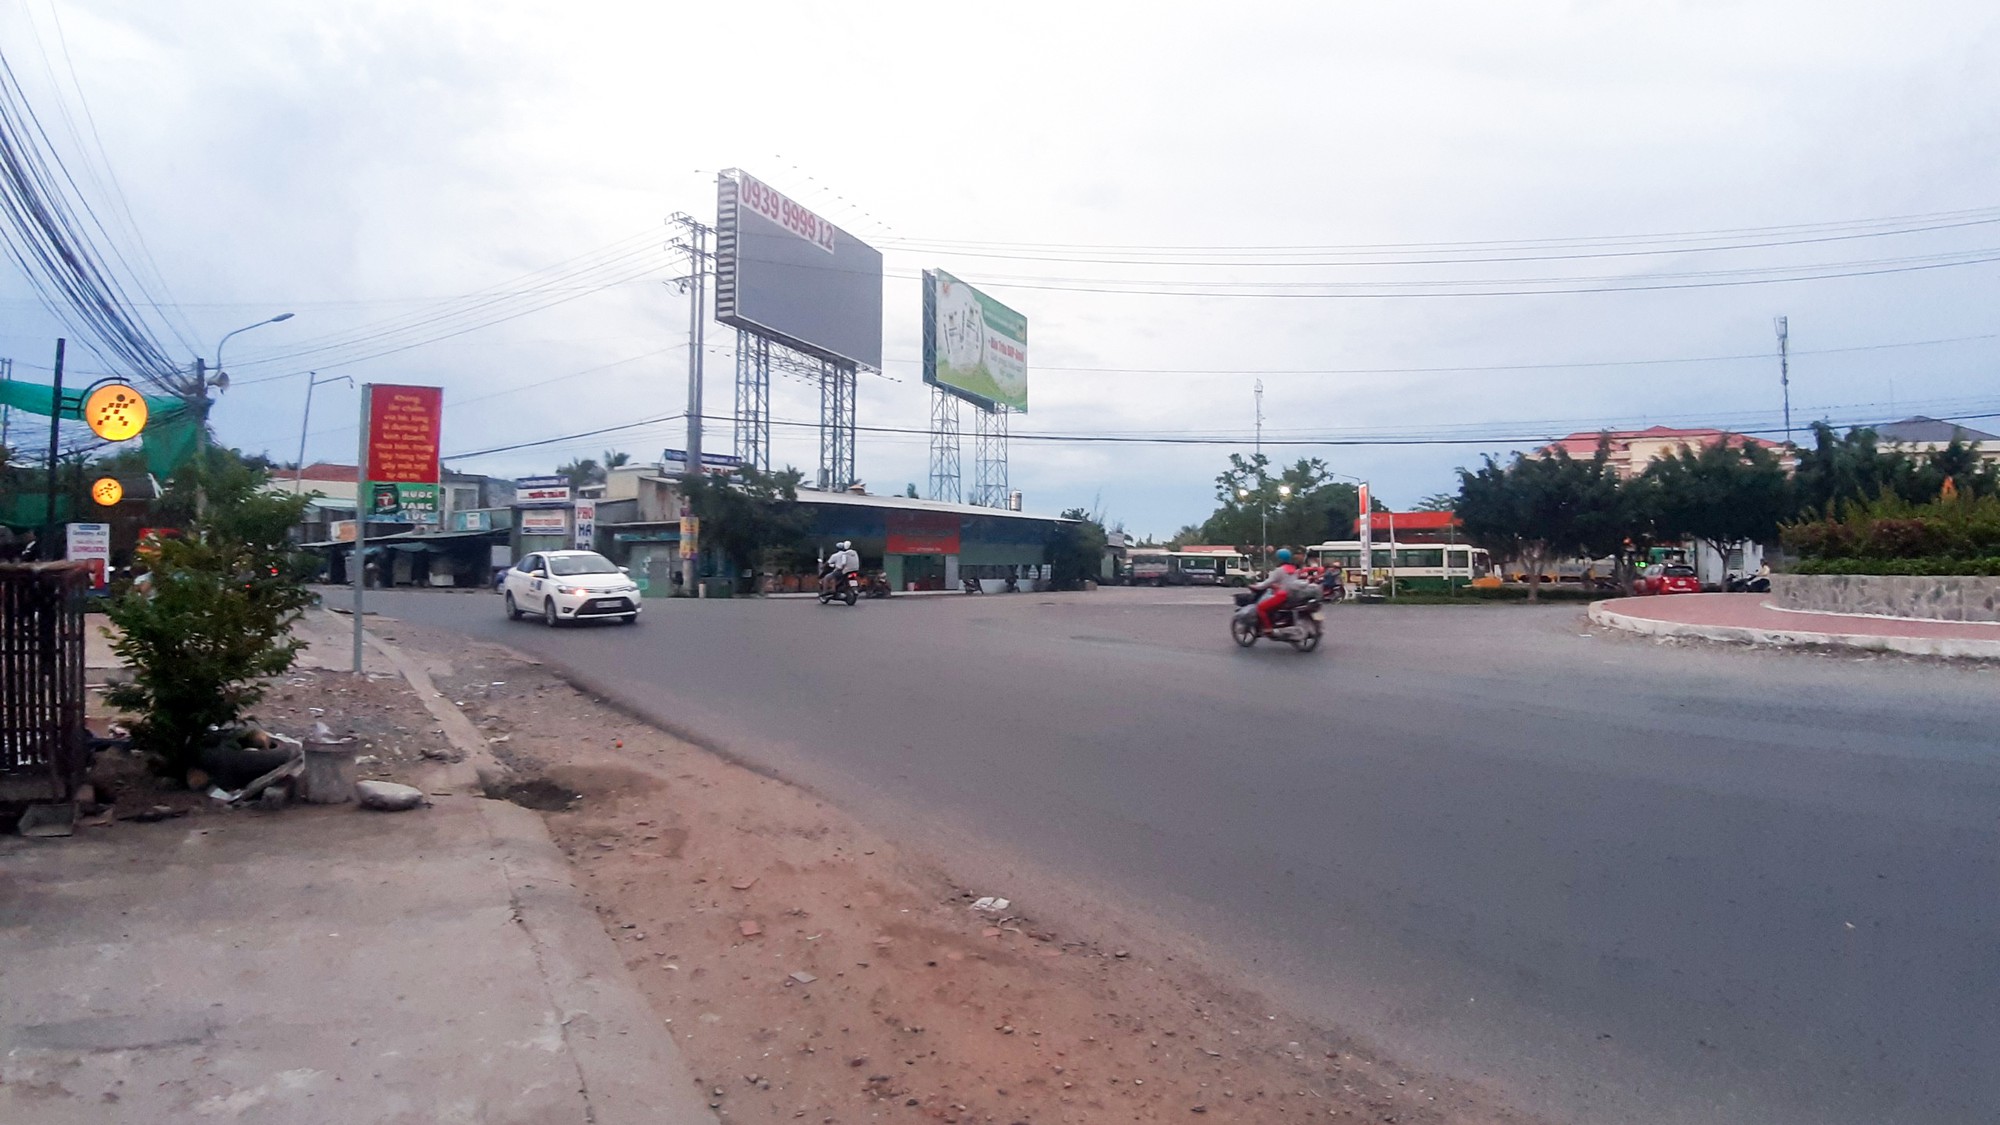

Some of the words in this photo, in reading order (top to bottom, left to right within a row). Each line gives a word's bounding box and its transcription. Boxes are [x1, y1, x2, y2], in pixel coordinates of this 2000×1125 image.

[741, 175, 780, 220] 0939
[782, 198, 817, 241] 9999
[818, 220, 833, 252] 12
